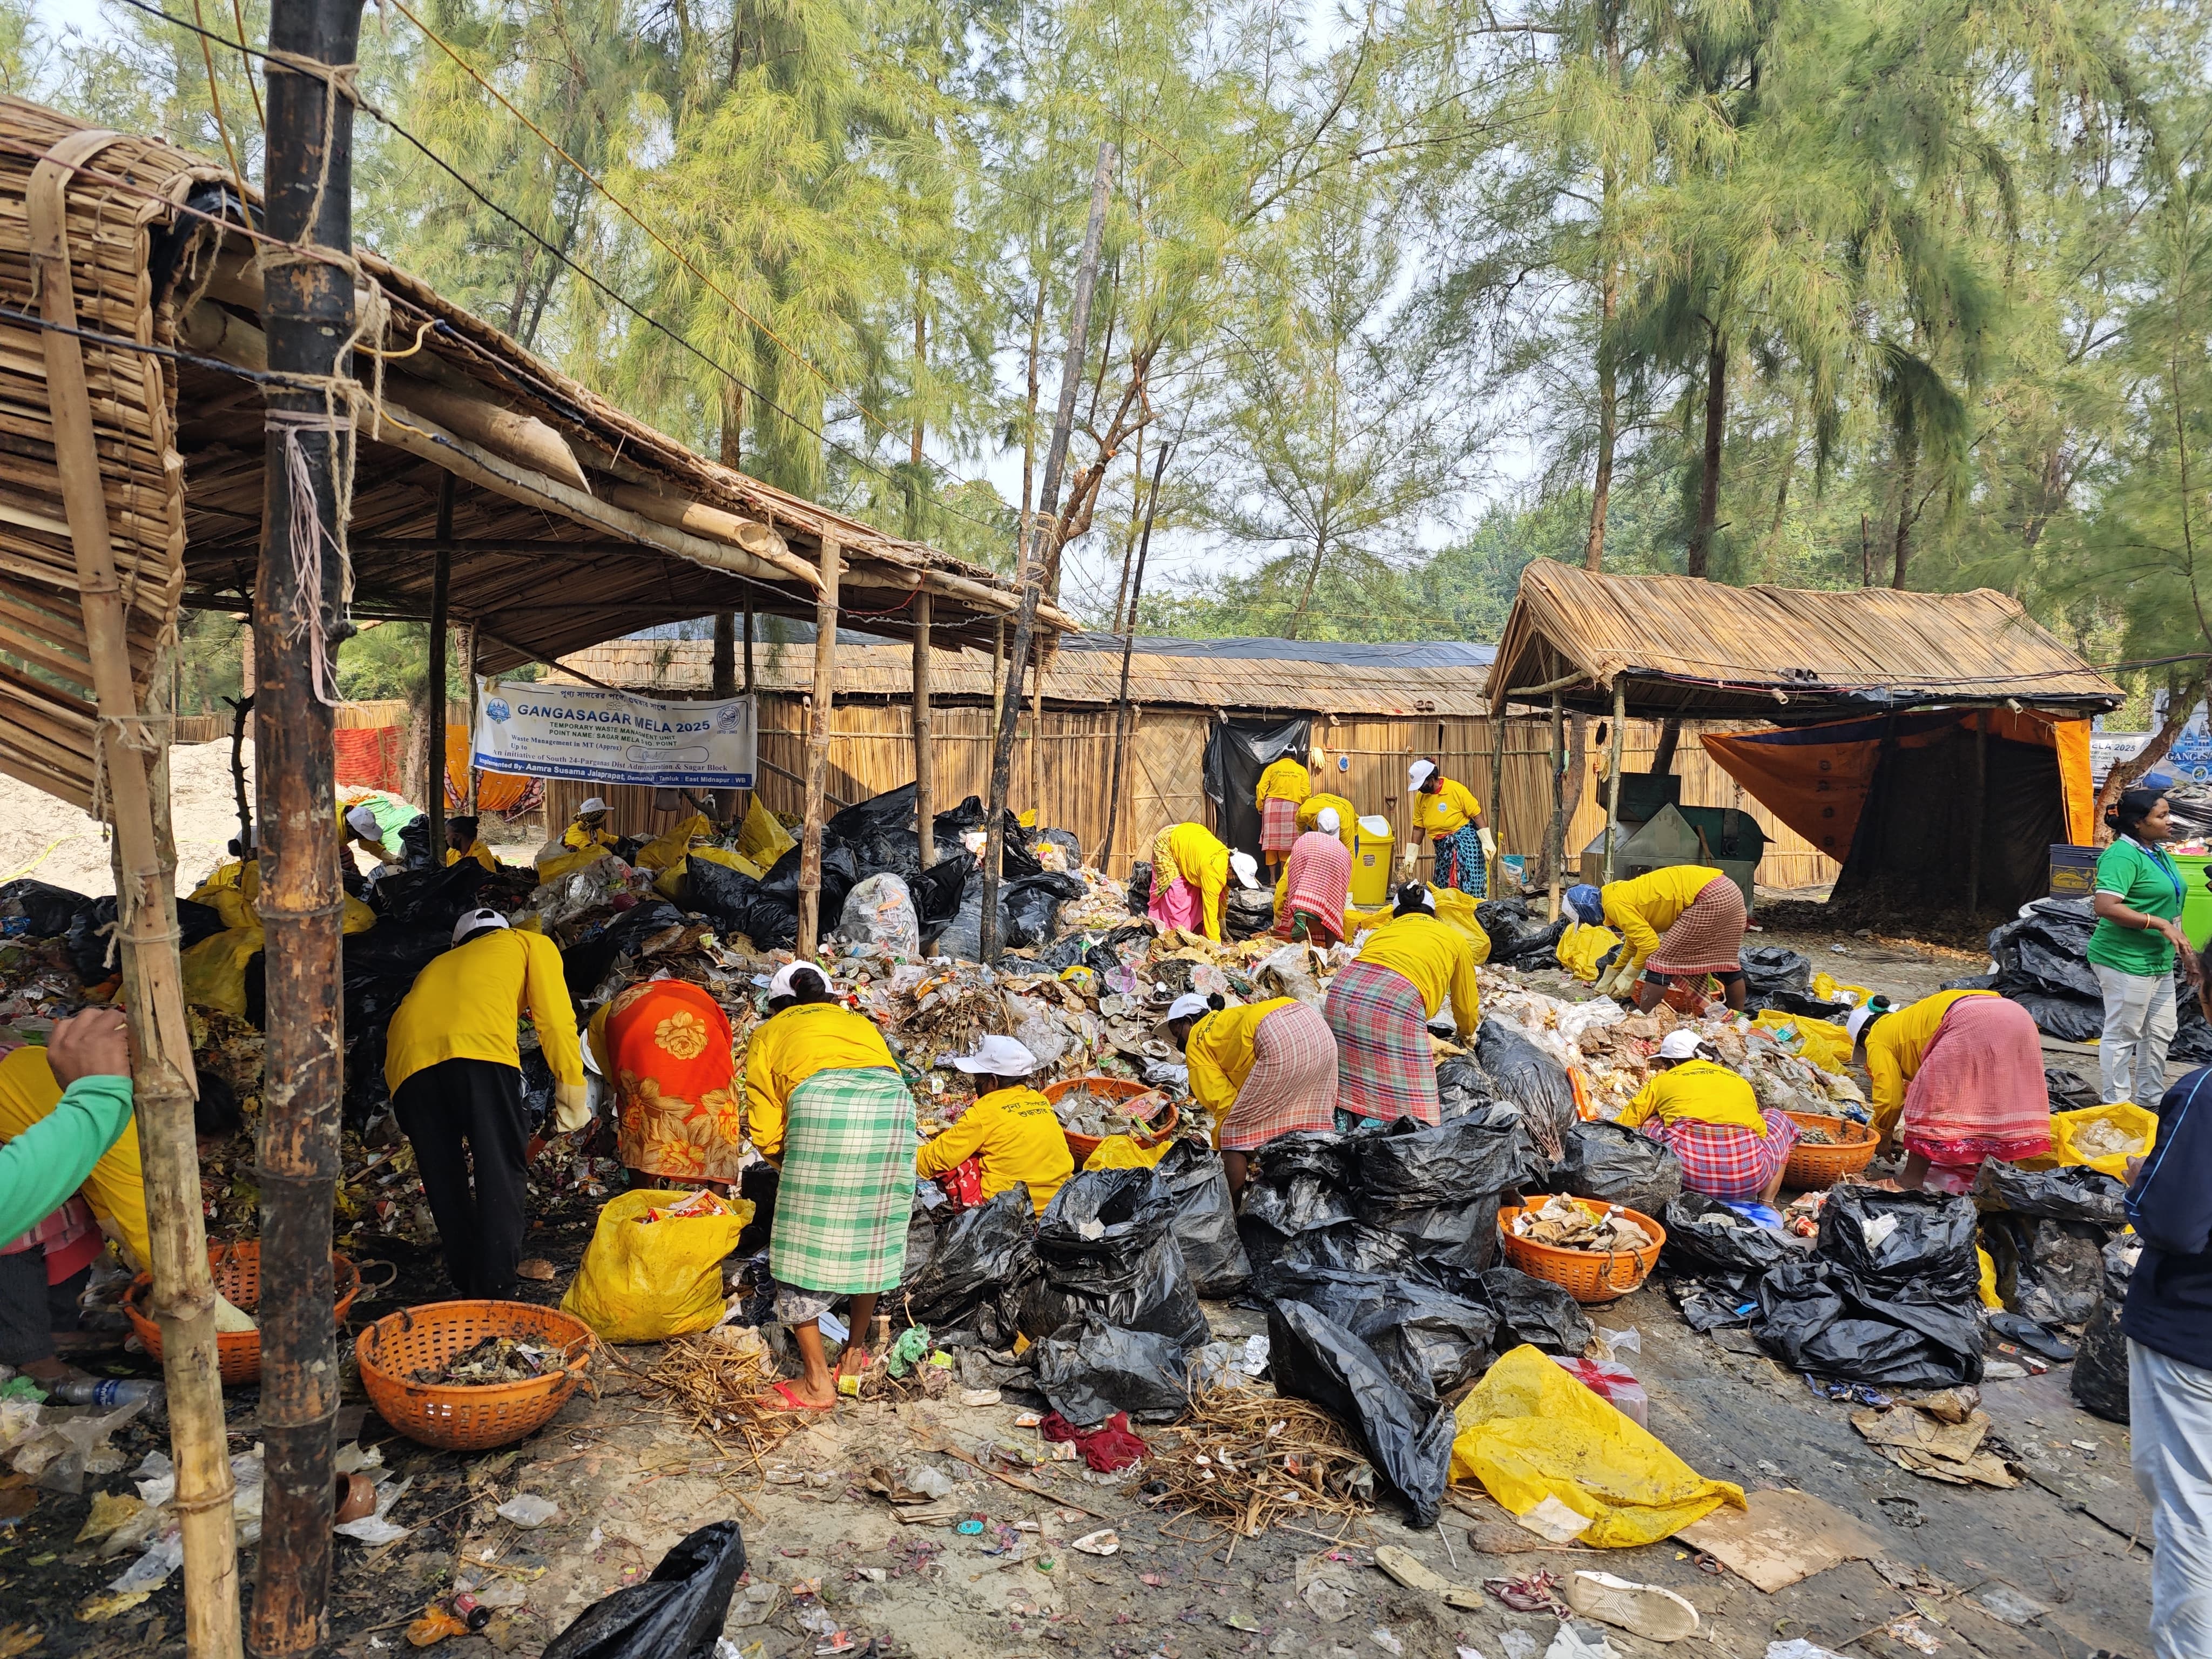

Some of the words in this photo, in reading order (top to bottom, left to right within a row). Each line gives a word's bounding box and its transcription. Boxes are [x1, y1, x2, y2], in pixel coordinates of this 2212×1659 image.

[517, 704, 631, 726] GANGASAGAR
[635, 717, 672, 733] MELA
[675, 720, 710, 733] 2025
[549, 729, 570, 737] POINT
[550, 721, 594, 731] TEMPORARY
[595, 725, 619, 733] WASTE
[621, 728, 657, 740] MANAGMENT
[511, 743, 519, 751] Up
[531, 736, 572, 746] Management
[596, 743, 622, 752] (Approx)
[2114, 744, 2136, 752] 2025
[479, 757, 512, 768] Implemented
[514, 763, 525, 771] By-
[525, 763, 552, 773] Aamra
[554, 766, 586, 776] Susama
[587, 769, 626, 781] Jalaprapat,
[504, 751, 536, 760] initiative
[547, 755, 567, 763] South
[570, 757, 610, 767] 24-Parganas
[627, 763, 673, 771] Administration
